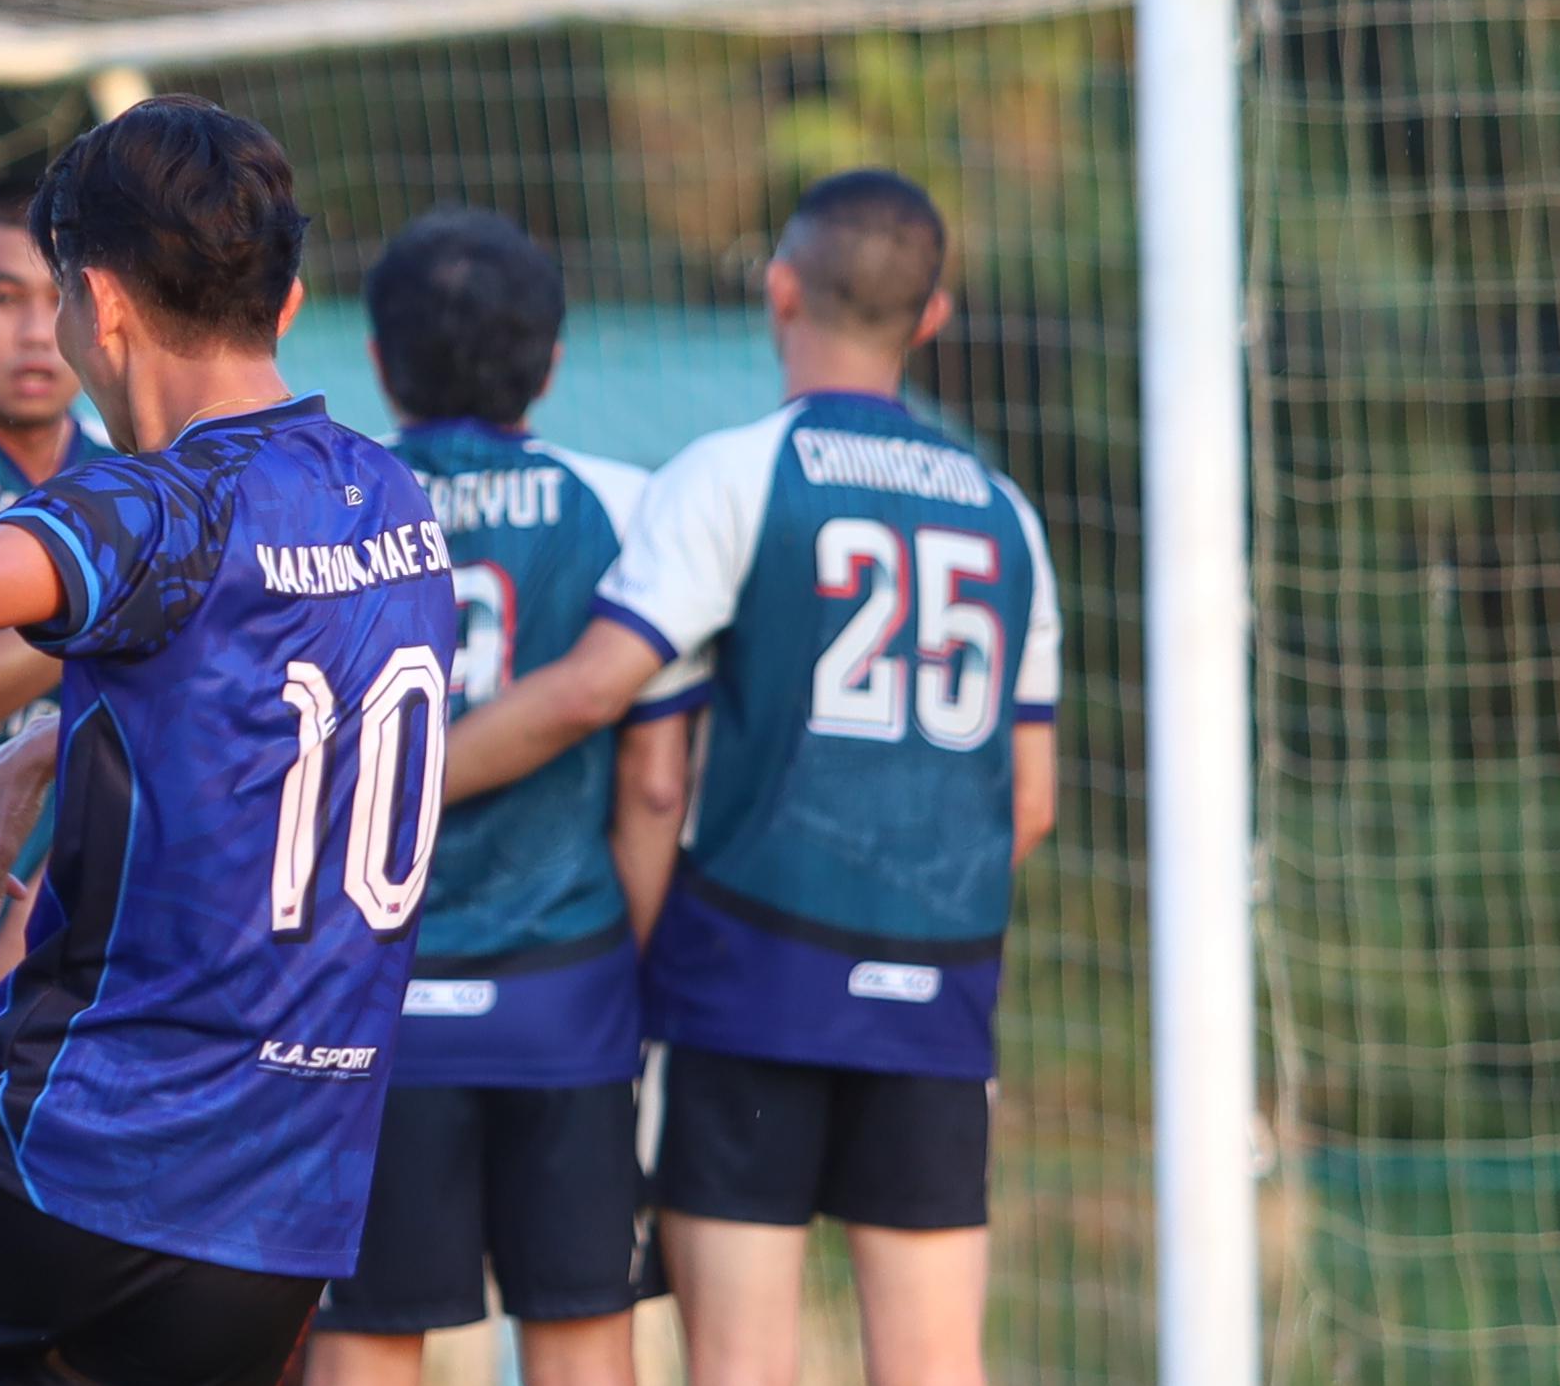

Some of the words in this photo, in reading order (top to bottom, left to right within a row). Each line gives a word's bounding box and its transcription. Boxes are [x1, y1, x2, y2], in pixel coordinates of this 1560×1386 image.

[256, 543, 367, 594] NAKHON
[362, 524, 422, 584] MAE
[808, 518, 1006, 752] 25
[270, 645, 446, 933] 10
[259, 1040, 377, 1069] K.A.SPORT
